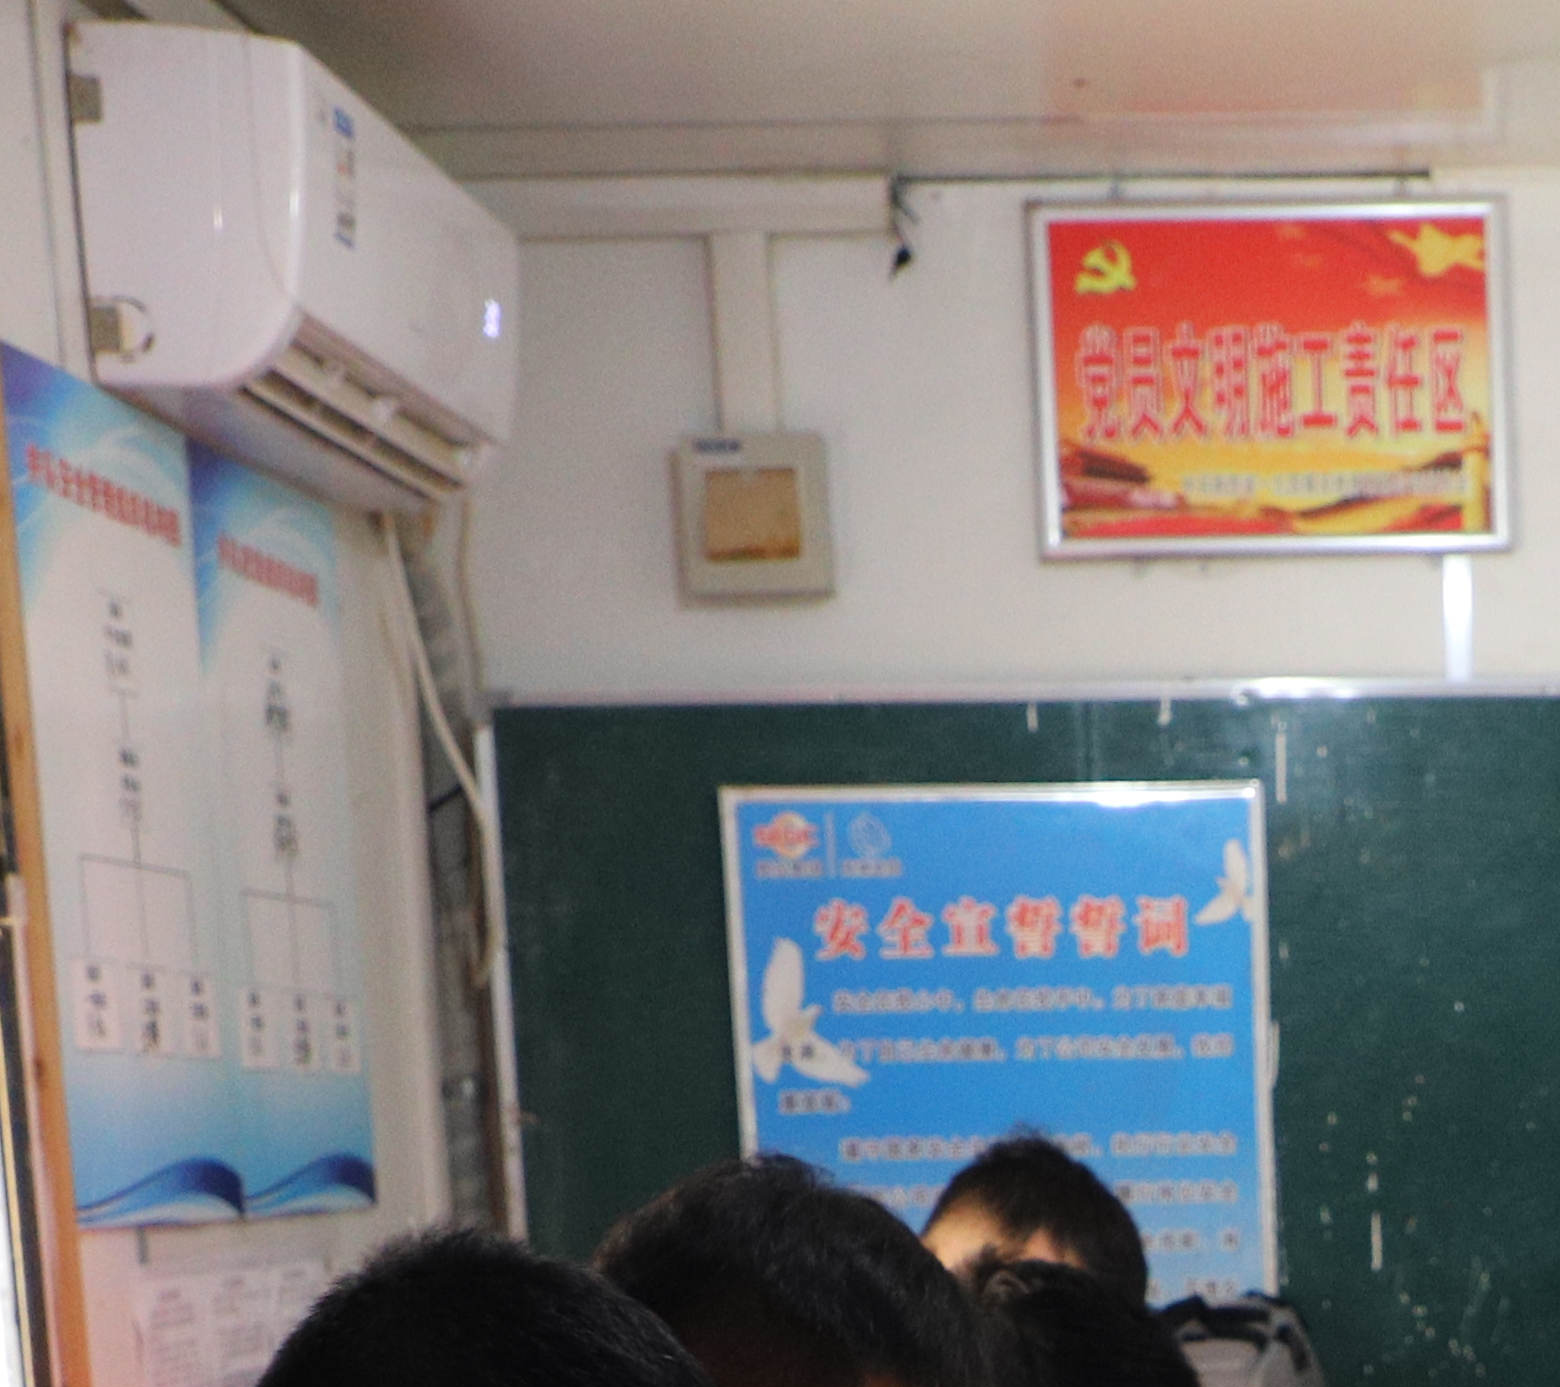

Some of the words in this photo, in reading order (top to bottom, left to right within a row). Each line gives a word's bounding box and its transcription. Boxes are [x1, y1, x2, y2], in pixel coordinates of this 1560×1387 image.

[1078, 322, 1466, 442] 党员文明施工责任区
